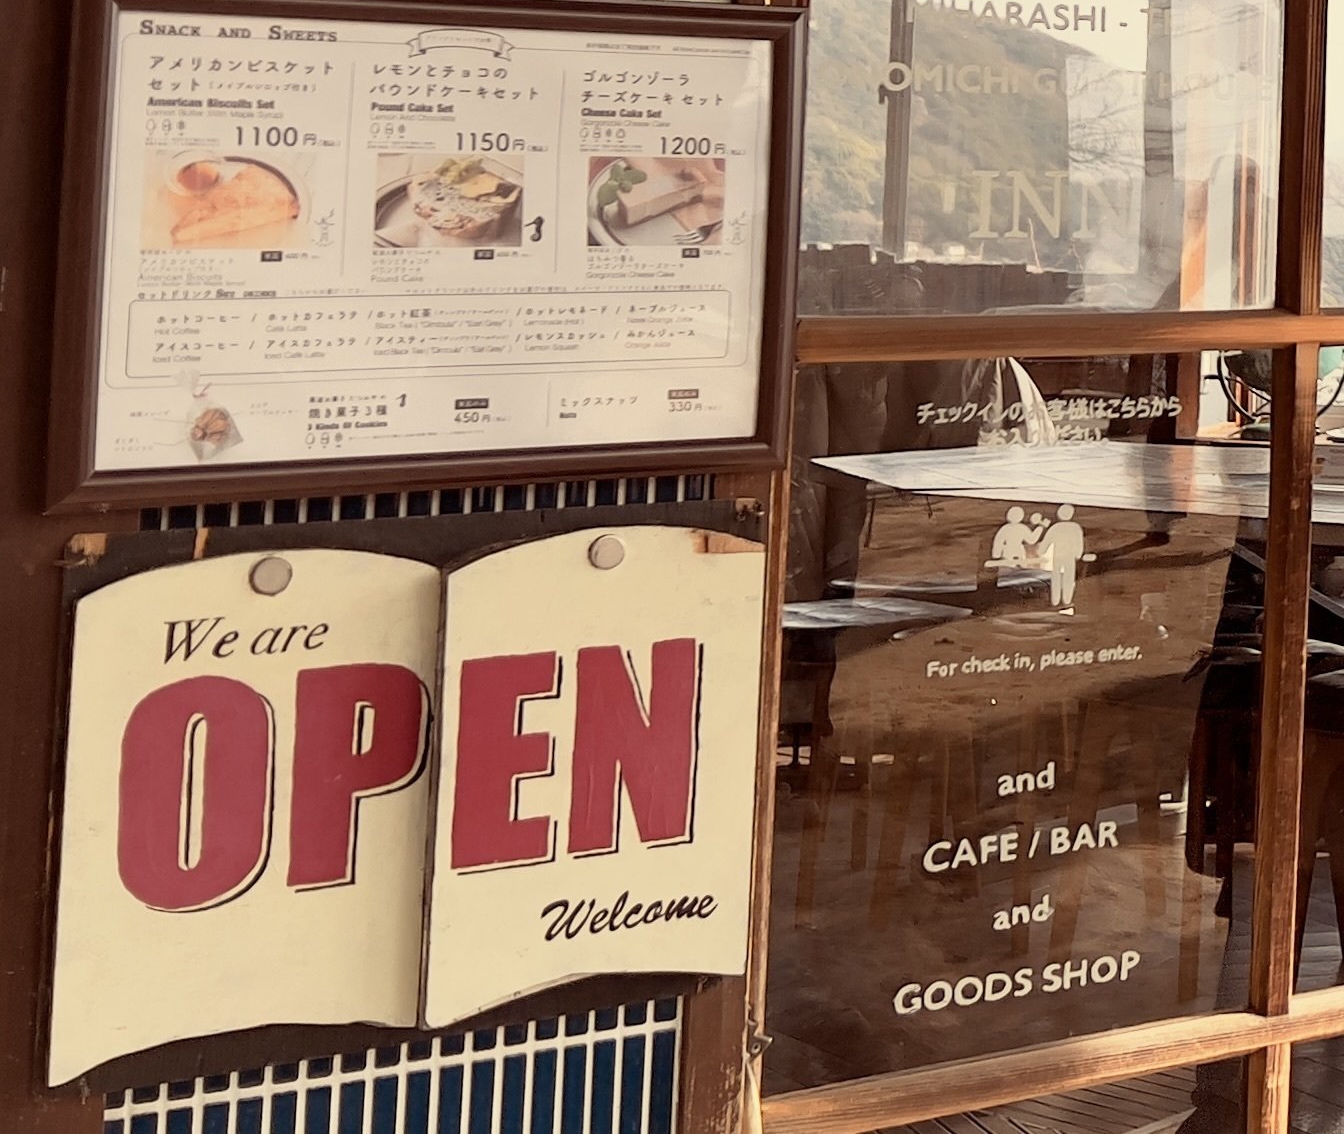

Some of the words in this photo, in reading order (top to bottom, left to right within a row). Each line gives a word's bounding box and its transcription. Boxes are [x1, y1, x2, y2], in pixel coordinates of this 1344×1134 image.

[149, 55, 334, 75] アメリカンビスケット
[373, 64, 508, 80] レモンとチョコの
[148, 77, 200, 92] セット
[583, 69, 690, 86] ゴルゴンゾーラ
[369, 84, 539, 100] パウンドケーキセット
[581, 89, 723, 106] チーズケーキセット
[147, 96, 202, 108] American
[207, 97, 252, 109] Biscuits
[256, 99, 275, 110] Set
[370, 102, 405, 112] Pound
[407, 103, 434, 113] Cake
[437, 103, 454, 113] Set
[580, 108, 616, 118] Cheese
[619, 109, 643, 118] Cake
[646, 110, 662, 118] Set
[157, 314, 240, 324] ホットコーヒー
[155, 342, 239, 352] アイスコーヒー
[917, 395, 1183, 425] チェックインの客様はこちらから
[162, 616, 241, 665] We
[250, 620, 329, 657] are
[926, 659, 957, 679] For
[960, 653, 1011, 676] check
[1013, 650, 1037, 673] in,
[1039, 645, 1096, 672] please
[1098, 643, 1143, 666] enter.
[117, 638, 704, 913] OPEN
[997, 762, 1056, 796] and
[922, 831, 1019, 874] CAFE
[1050, 820, 1120, 857] BAR
[539, 888, 720, 943] Welcome
[992, 895, 1056, 932] and
[892, 967, 1034, 1017] GOODS
[1041, 950, 1141, 992] SHOP
